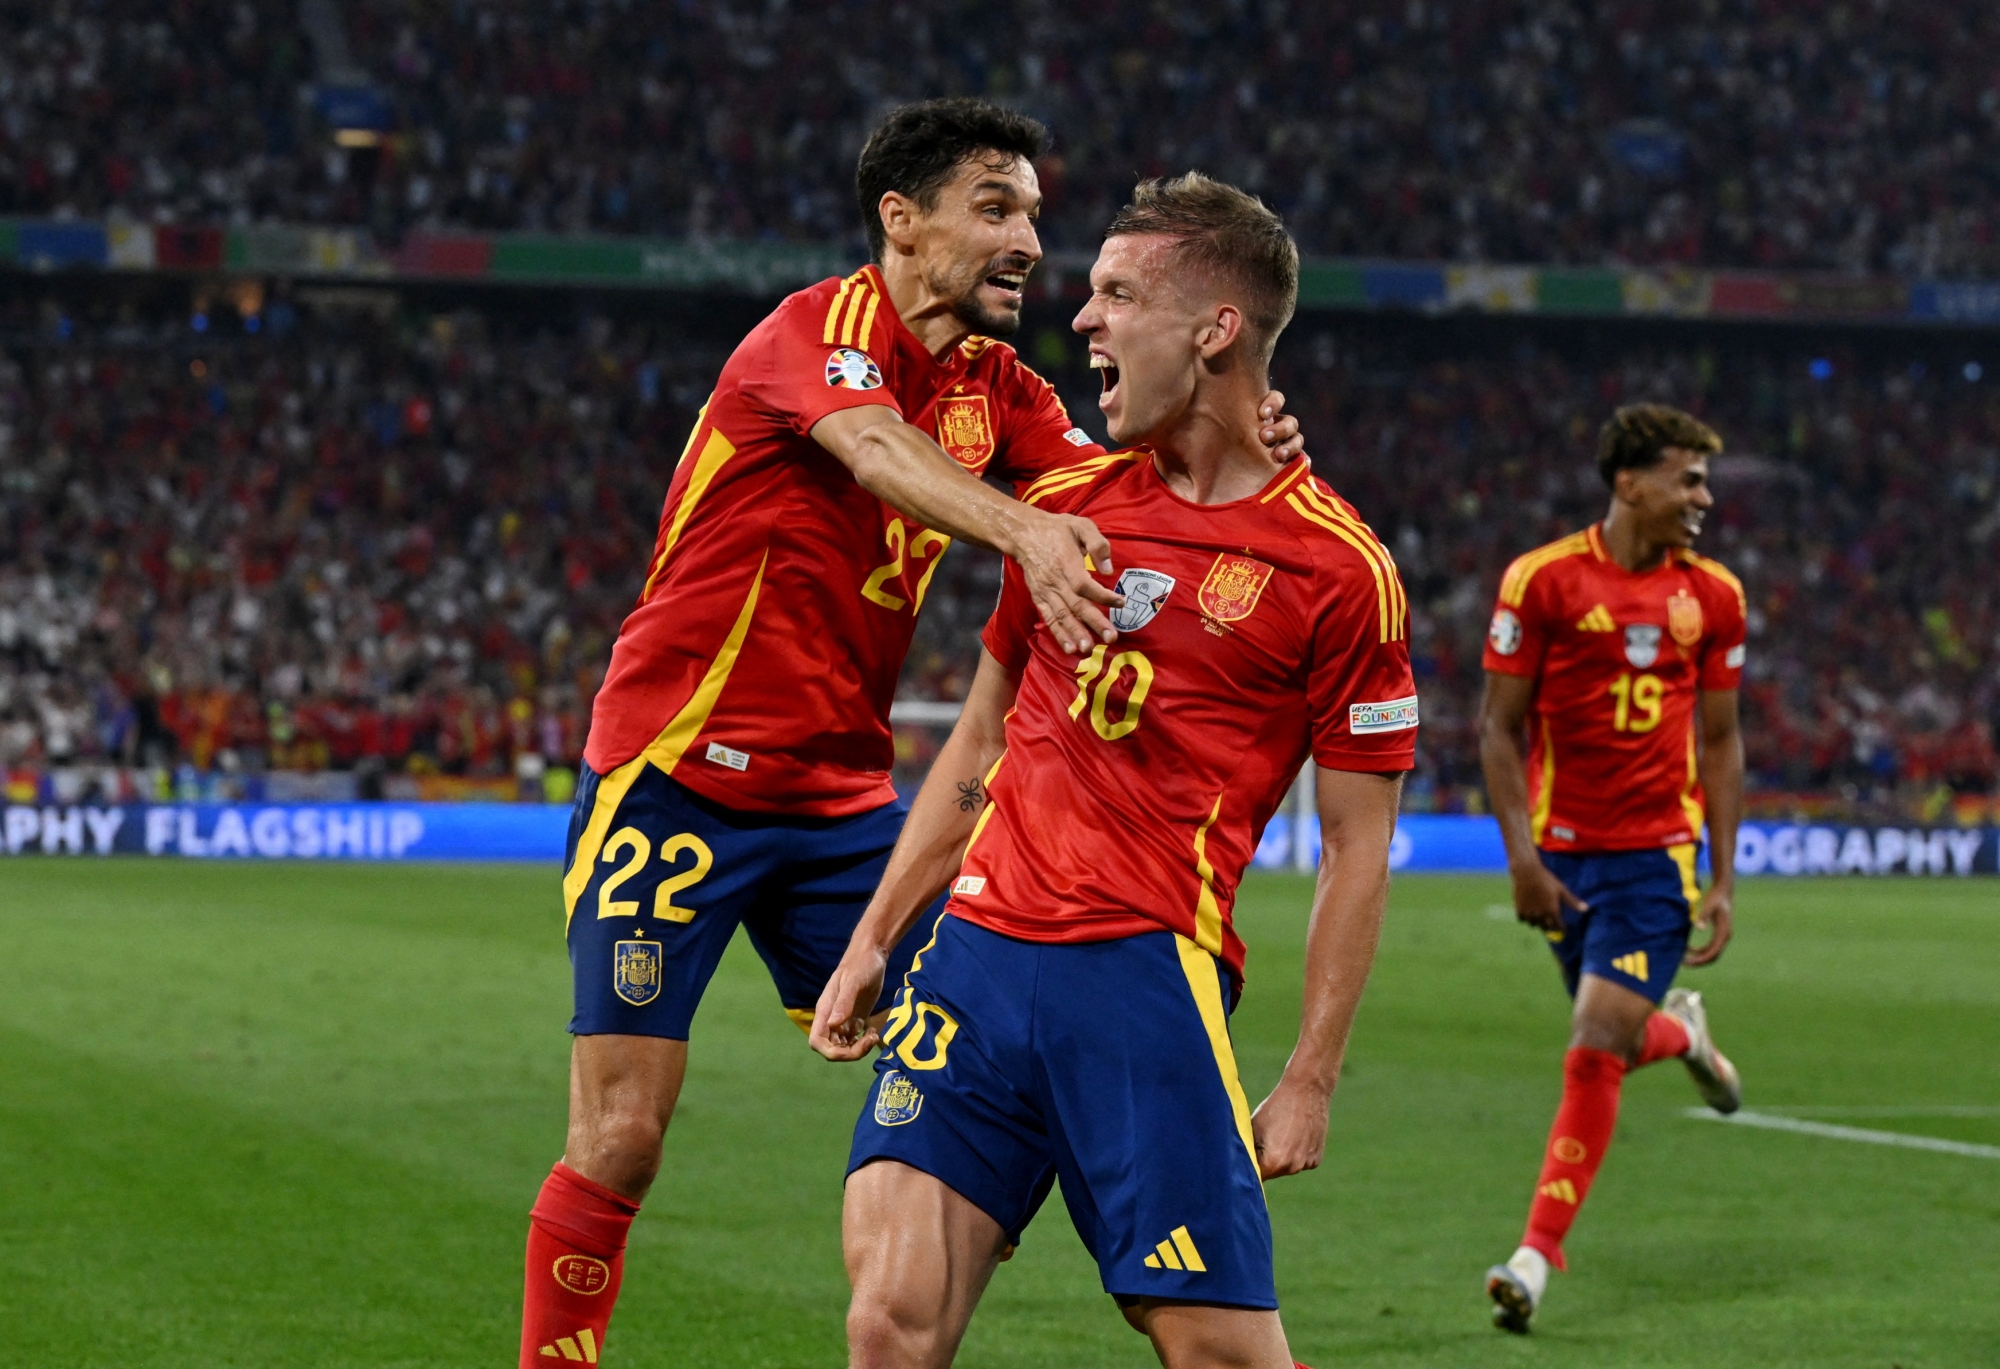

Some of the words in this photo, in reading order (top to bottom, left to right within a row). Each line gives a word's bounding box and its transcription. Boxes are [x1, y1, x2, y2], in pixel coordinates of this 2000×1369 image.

[861, 517, 951, 617] 22
[1067, 644, 1154, 741] 10
[1609, 673, 1664, 733] 19
[0, 805, 124, 856] PHY
[145, 806, 425, 858] FLAGSHIP
[597, 826, 713, 923] 22
[882, 987, 960, 1070] 10
